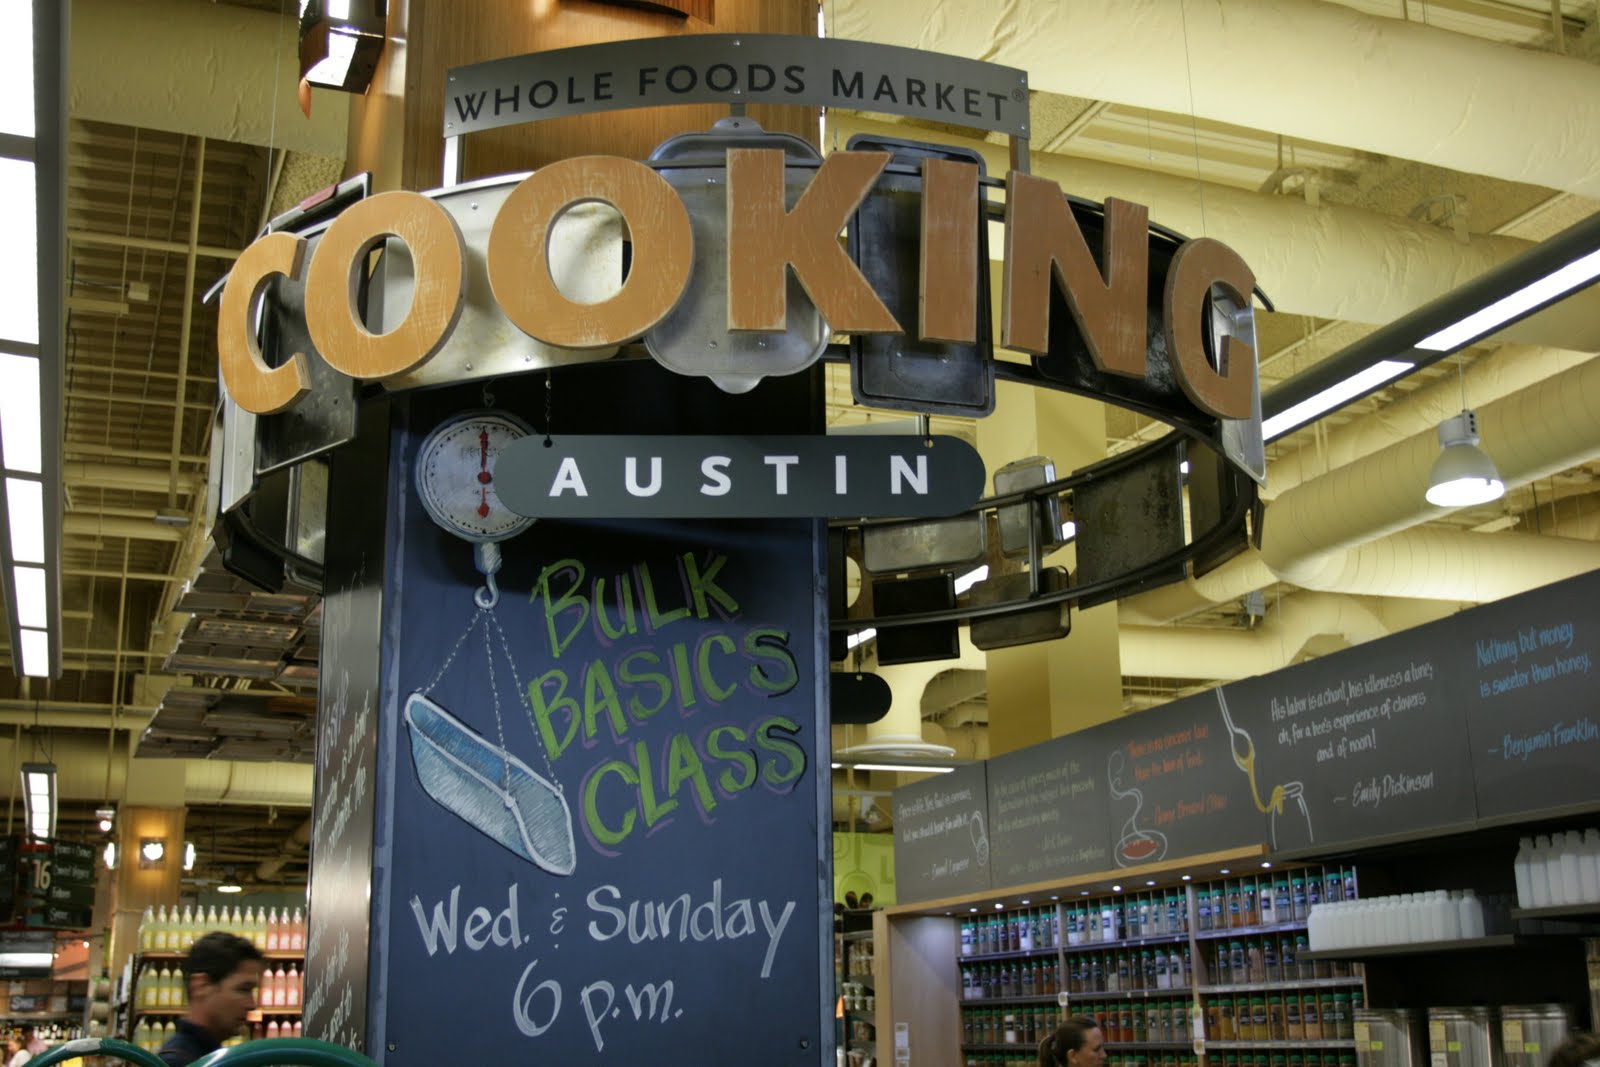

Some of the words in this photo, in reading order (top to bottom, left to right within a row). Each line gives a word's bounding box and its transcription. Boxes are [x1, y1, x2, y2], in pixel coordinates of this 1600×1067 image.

[454, 72, 613, 123] WHOLE
[639, 63, 806, 96] FOODS
[217, 147, 1257, 421] COOKING
[548, 455, 929, 497] AUSTIN
[530, 551, 742, 658] BULK
[1475, 638, 1519, 668] Nothing
[1518, 625, 1537, 654] but
[1539, 621, 1575, 648] money
[526, 624, 800, 761] BASICS
[1270, 696, 1286, 722] His
[1286, 694, 1306, 718] labor
[1348, 680, 1364, 698] his
[1364, 672, 1403, 694] idleness
[1480, 679, 1491, 698] is
[1492, 669, 1529, 695] sweeter
[1531, 663, 1555, 685] than
[1555, 652, 1592, 675] honey.
[1292, 722, 1306, 744] for
[1333, 704, 1379, 732] experience
[1380, 698, 1393, 720] of
[1392, 692, 1427, 713] clovers
[1503, 732, 1551, 761] Benjamin
[1552, 717, 1599, 746] Franklin
[1317, 742, 1334, 762] and
[1337, 738, 1347, 759] of
[1349, 728, 1377, 753] noon!
[579, 716, 808, 856] CLASS
[1352, 777, 1381, 808] Emily
[1383, 771, 1434, 798] Dickinson
[32, 859, 52, 890] 16
[409, 874, 530, 957] Wed.
[586, 877, 797, 978] Sunday
[512, 958, 563, 1038] 6
[579, 979, 684, 1053] p.m.
